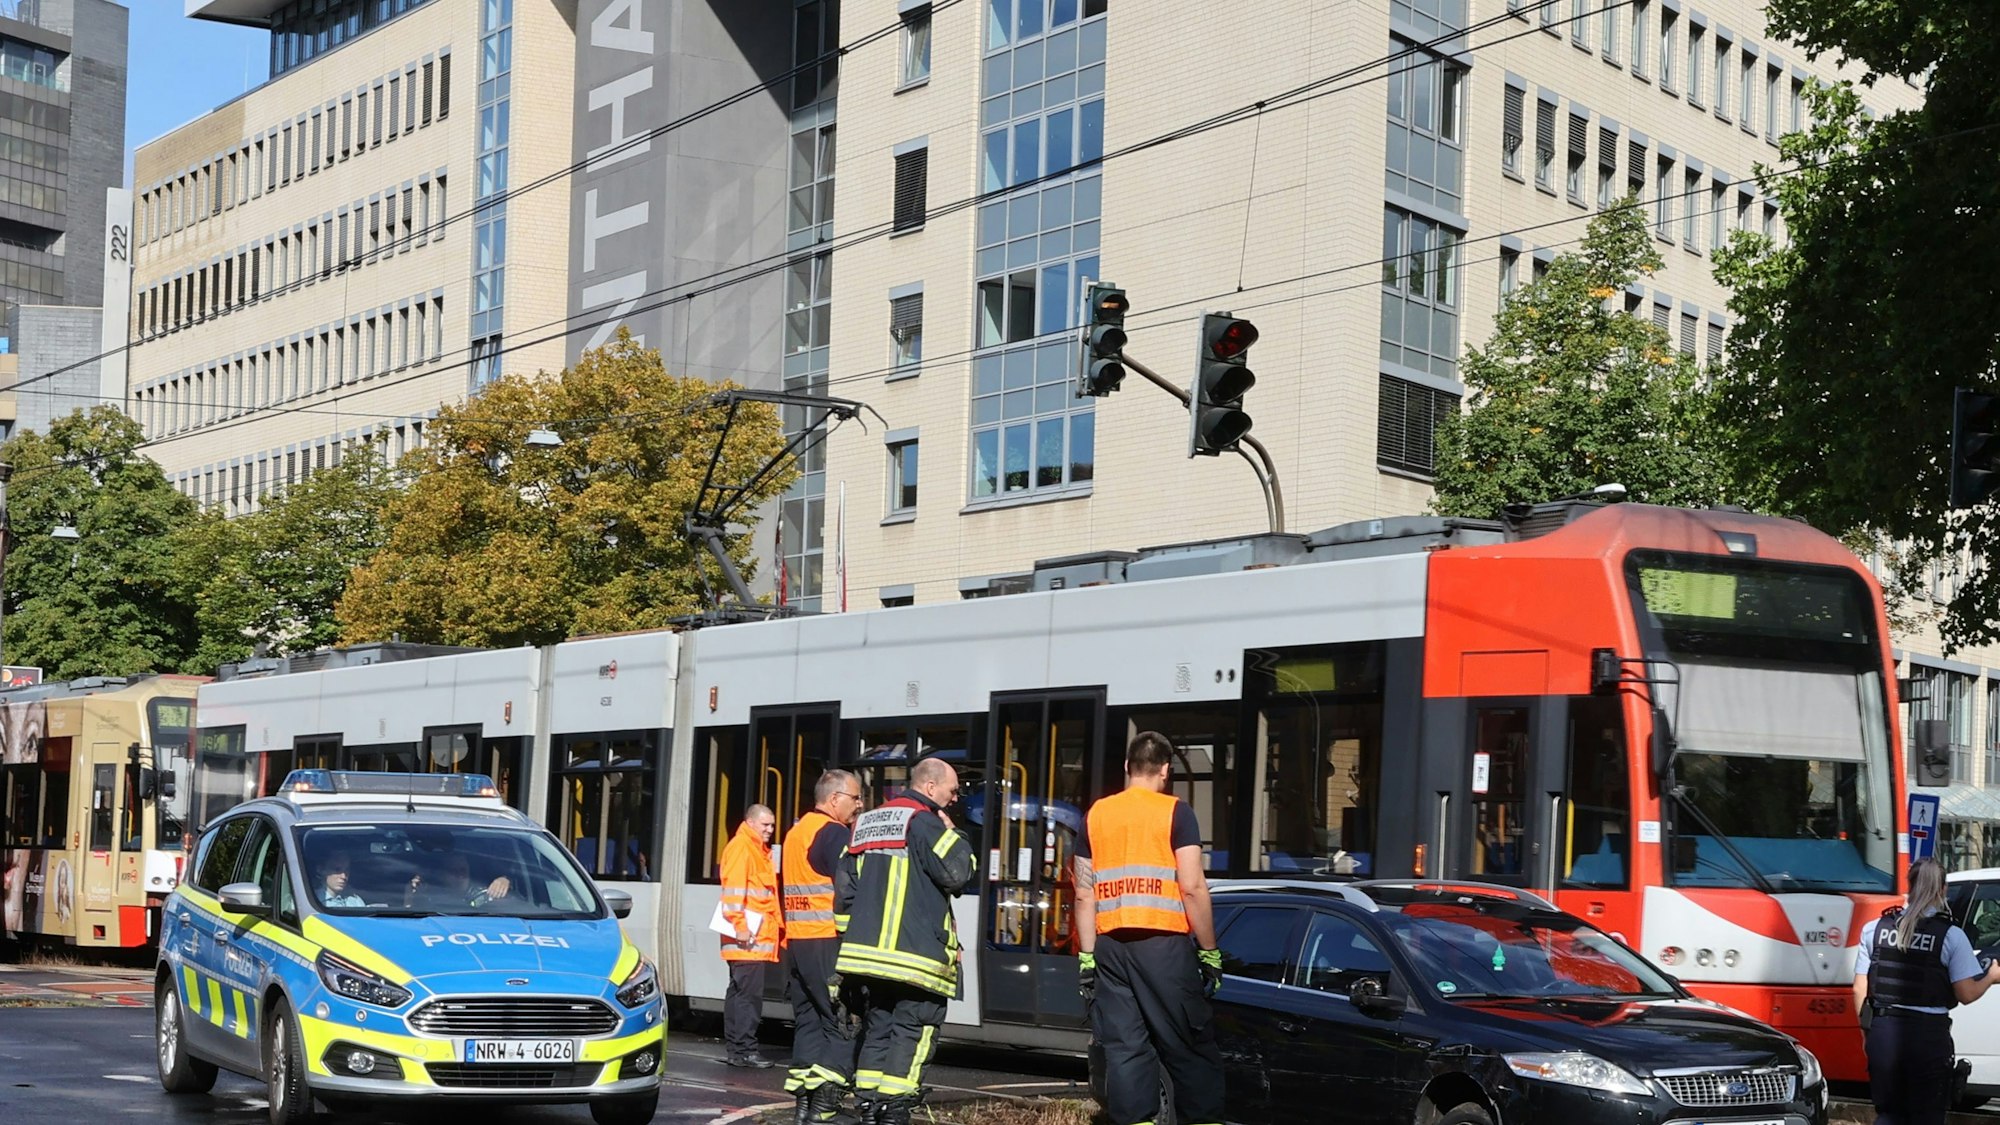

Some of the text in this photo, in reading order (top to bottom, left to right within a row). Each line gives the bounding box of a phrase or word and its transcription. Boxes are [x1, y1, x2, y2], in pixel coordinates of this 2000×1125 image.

[111, 224, 127, 262] 222
[420, 933, 570, 949] POLIZEI
[1878, 929, 1936, 952] POZEI
[476, 1042, 506, 1059] NRW
[516, 1042, 572, 1059] 4-6026
